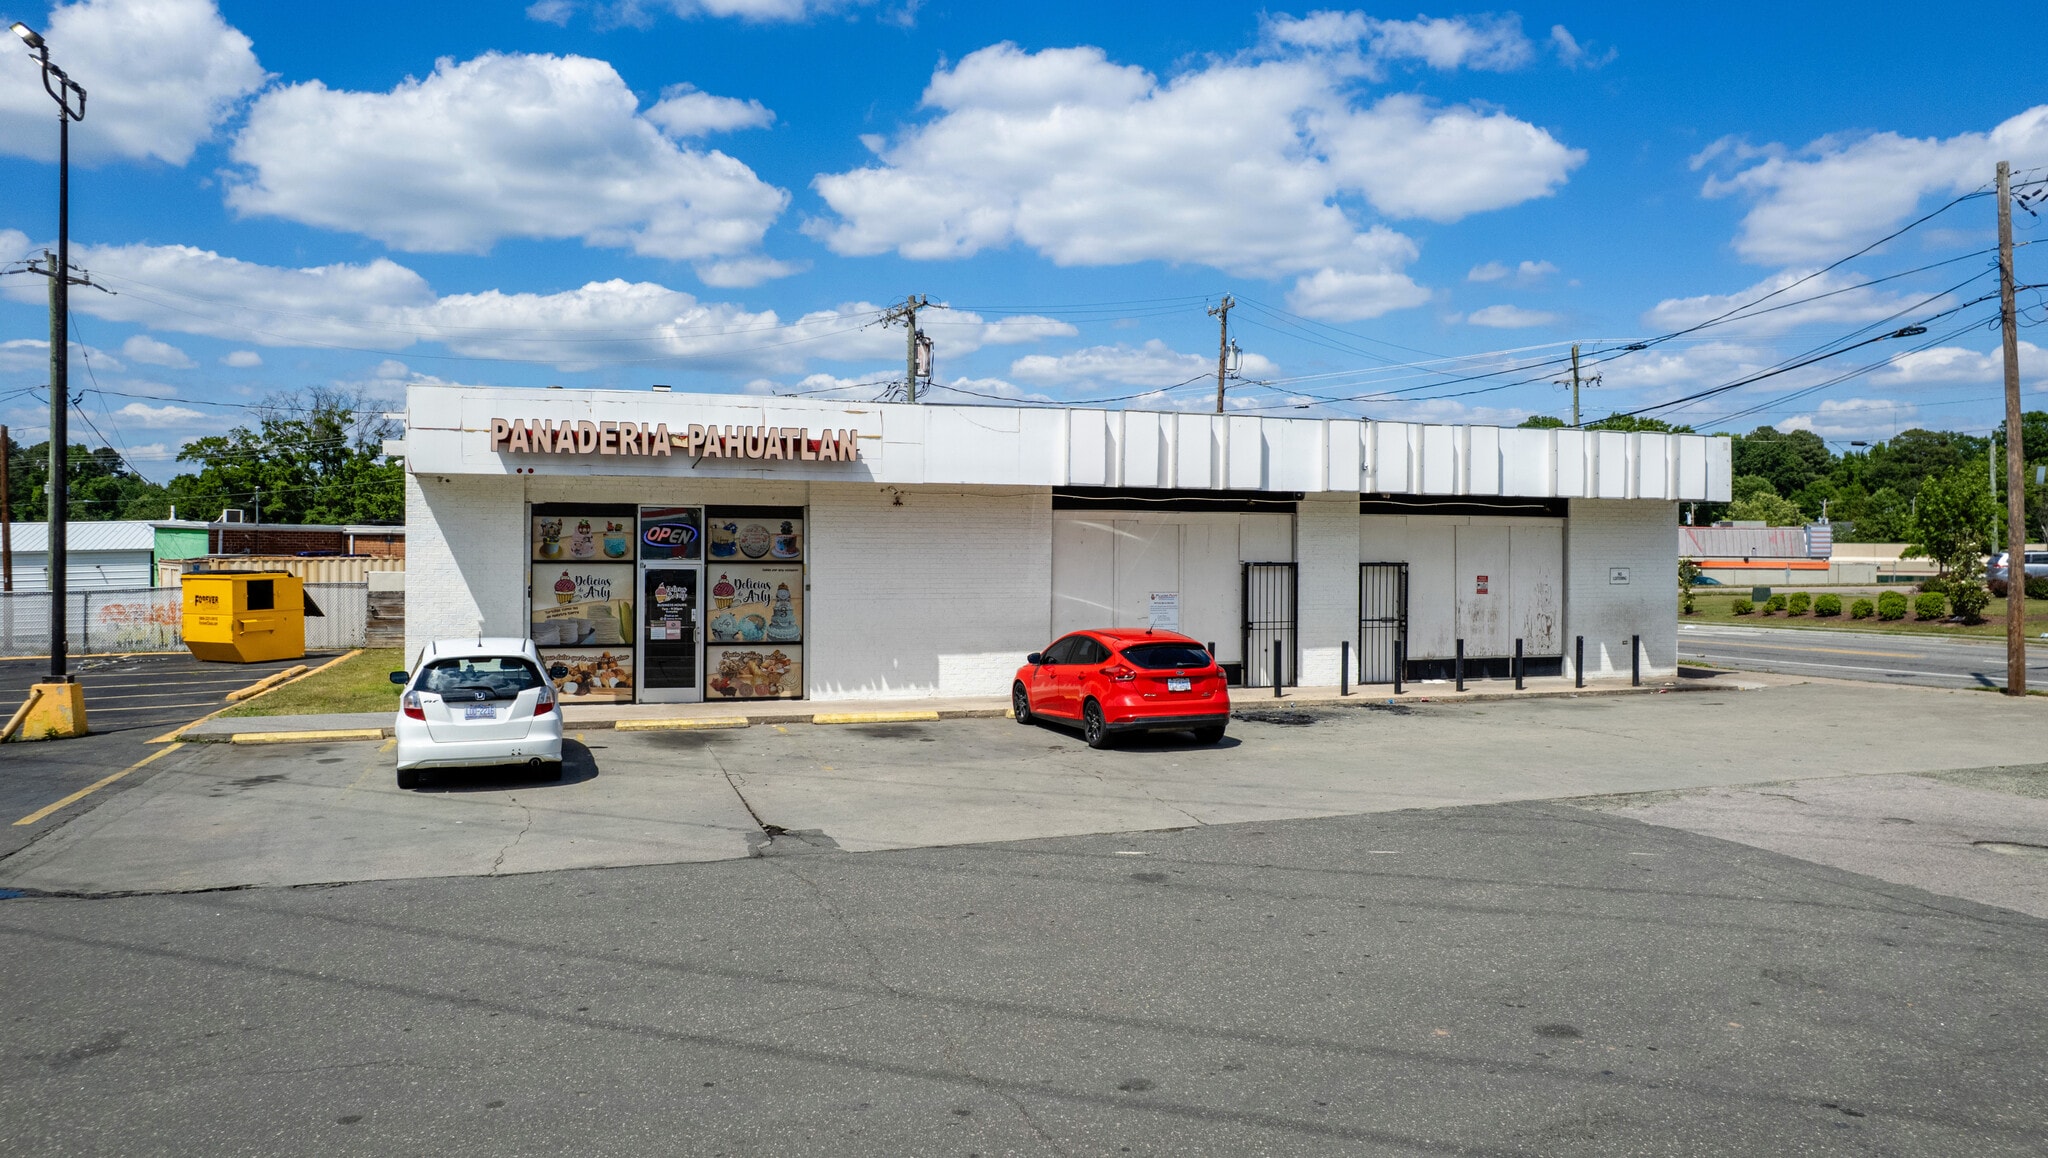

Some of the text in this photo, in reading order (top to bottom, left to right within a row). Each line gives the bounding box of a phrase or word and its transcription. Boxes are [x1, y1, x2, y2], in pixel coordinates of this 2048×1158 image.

[490, 418, 858, 462] PANADERIA PAHUATLAN
[647, 526, 692, 544] OPEN
[575, 574, 611, 586] Delicias
[734, 578, 771, 590] Delicias
[583, 586, 611, 602] Arly
[743, 590, 771, 607] Arly
